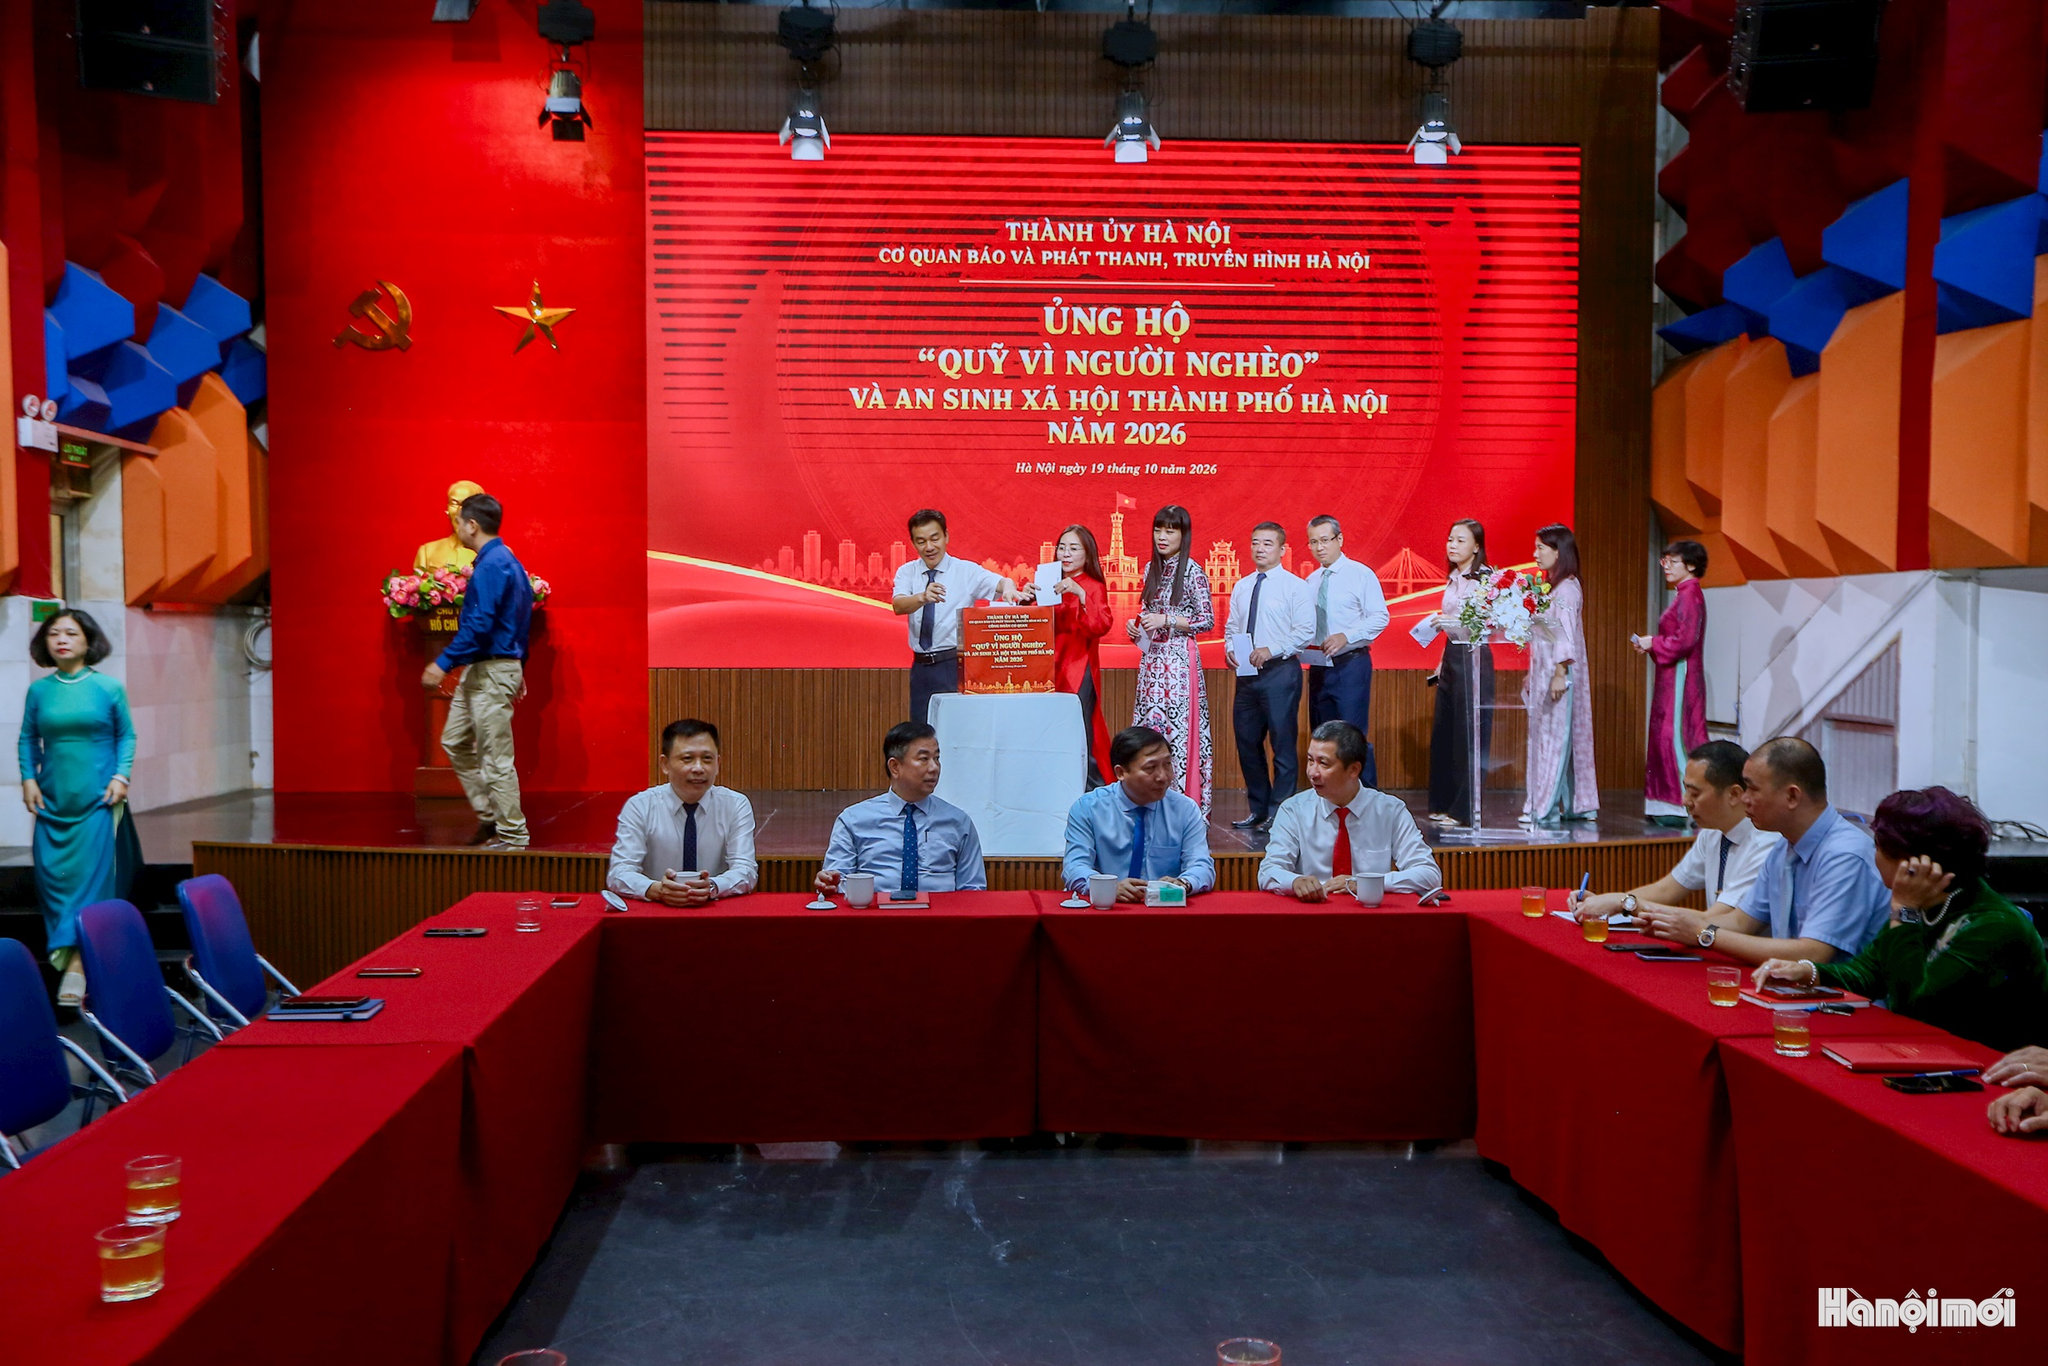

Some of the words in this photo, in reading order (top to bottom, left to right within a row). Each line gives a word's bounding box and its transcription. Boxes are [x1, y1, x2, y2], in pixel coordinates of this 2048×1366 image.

[1005, 217, 1094, 242] THÀNH
[1102, 217, 1136, 243] ỦY
[1143, 219, 1179, 244] HÀ
[1186, 220, 1231, 248] NỘI
[878, 246, 905, 264] CƠ
[909, 248, 962, 267] QUAN
[967, 245, 1006, 265] BÁO
[1010, 246, 1036, 265] VÀ
[1041, 246, 1092, 266] PHÁT
[1095, 251, 1168, 270] THANH,
[1173, 245, 1248, 268] TRUYỀN
[1253, 249, 1301, 269] HÌNH
[1306, 250, 1333, 269] HÀ
[1337, 251, 1370, 273] NỘI
[1043, 296, 1124, 336] ỦNG
[1134, 300, 1190, 344] HỘ
[918, 342, 1010, 379] “QUỸ
[1018, 342, 1055, 375] VÌ
[1064, 343, 1176, 377] NGƯỜI
[1185, 344, 1319, 378] NGHÈO”
[848, 381, 887, 410] VÀ
[893, 387, 935, 410] AN
[942, 387, 1013, 411] SINH
[1020, 384, 1061, 411] XÃ
[1068, 384, 1120, 416] HỘI
[1127, 386, 1229, 413] THÀNH
[1236, 383, 1294, 413] PHỐ
[1300, 387, 1337, 414] HÀ
[1342, 388, 1389, 420] NỘI
[1047, 418, 1116, 445] NĂM
[1123, 421, 1187, 446] 2026
[1015, 462, 1033, 473] Hà
[1035, 462, 1056, 476] Nội
[1058, 462, 1088, 476] ngày
[1091, 462, 1105, 474] 19
[1106, 462, 1141, 477] tháng
[1144, 463, 1159, 474] 10
[1160, 463, 1186, 475] năm
[1188, 463, 1218, 475] 2026
[1011, 634, 1023, 642] HỘ
